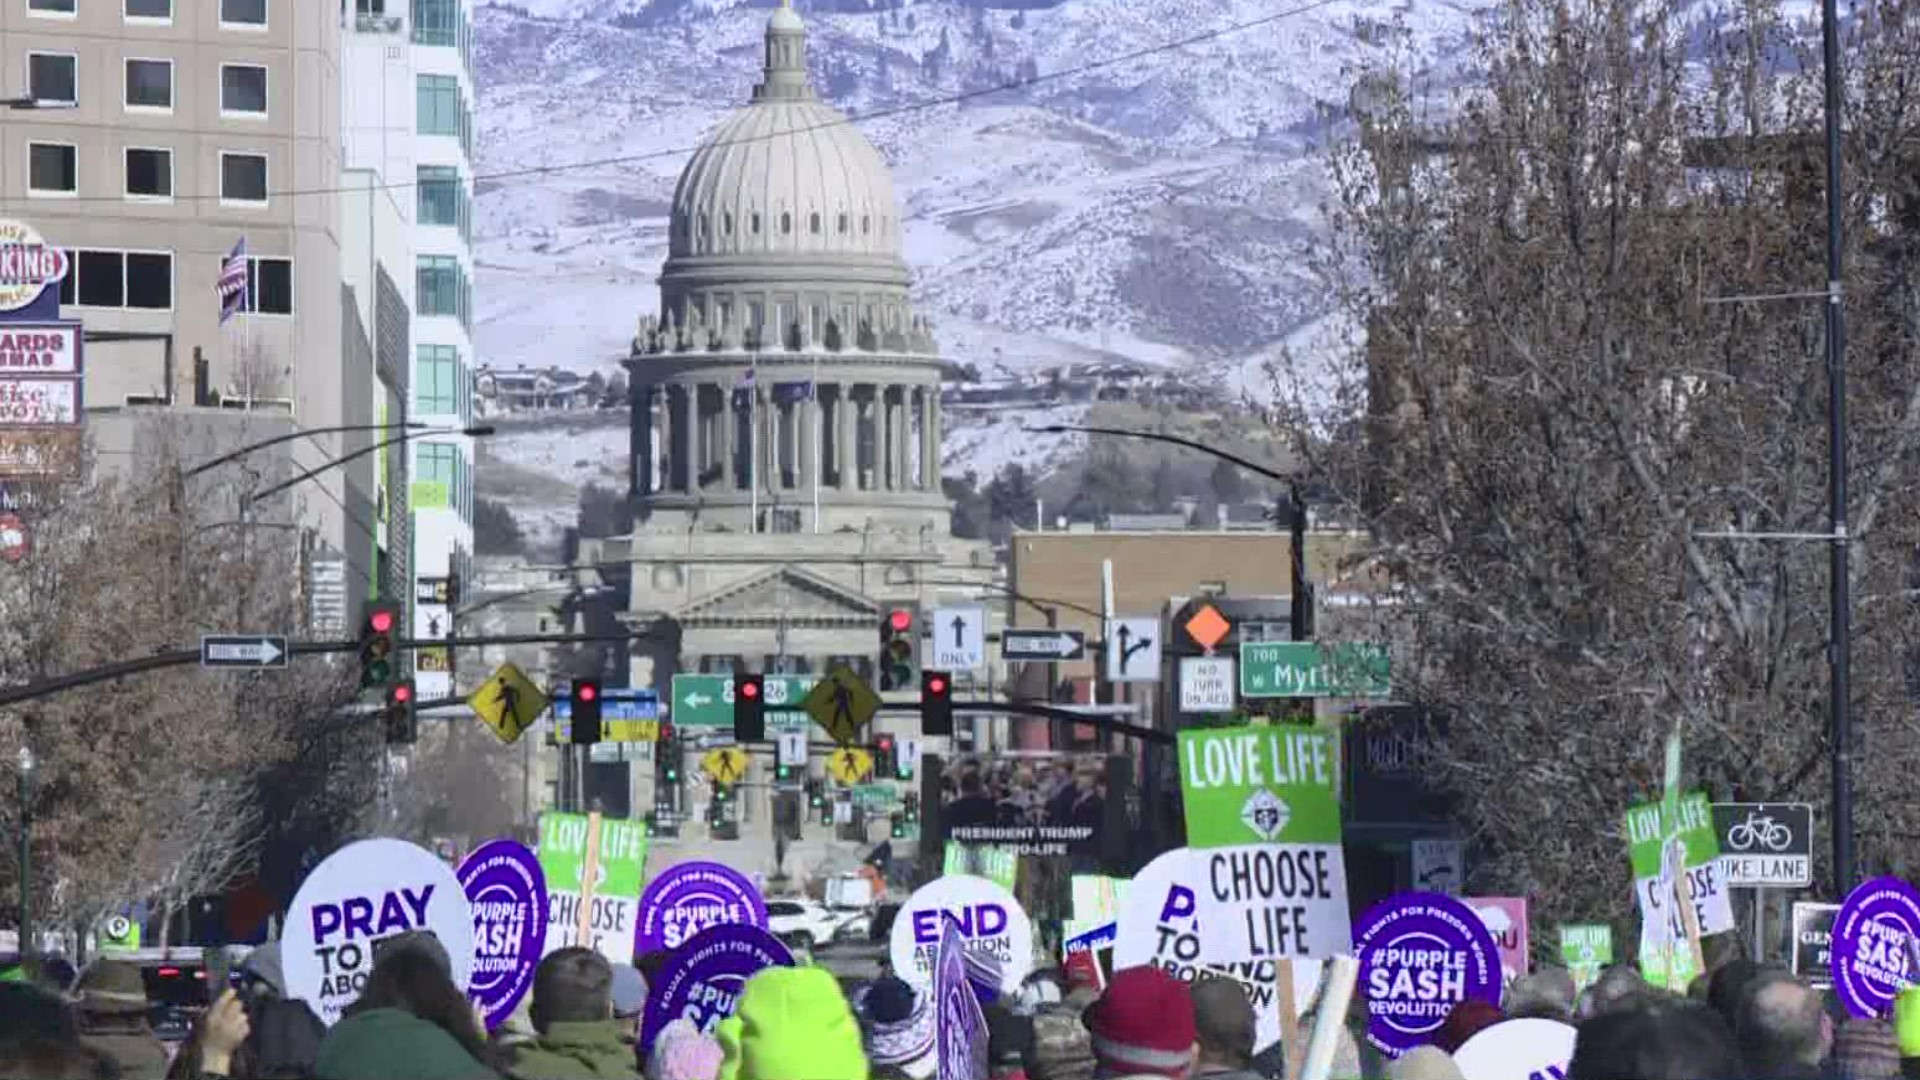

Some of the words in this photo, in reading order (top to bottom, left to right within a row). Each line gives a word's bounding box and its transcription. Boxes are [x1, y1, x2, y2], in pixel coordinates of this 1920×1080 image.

[940, 650, 977, 664] ONLY
[1197, 664, 1218, 675] NO
[1192, 679, 1223, 690] TURN
[1186, 733, 1265, 789] LOVE
[1269, 731, 1330, 787] LIFE
[951, 826, 1034, 840] PRESIDENT
[1039, 826, 1093, 840] TRUMP
[1627, 807, 1662, 845] LOV
[1680, 796, 1708, 833] LIFE
[546, 818, 588, 855] LOV
[602, 820, 641, 860] LIFE
[1210, 850, 1331, 903] CHOOSE
[1761, 859, 1805, 880] LANE
[1647, 865, 1718, 910] COSE
[311, 884, 436, 945] PRAY
[663, 903, 742, 925] #PURPLE
[912, 903, 1008, 943] END
[730, 940, 753, 954] FOR
[914, 936, 1011, 959] ABTION
[1156, 925, 1200, 961] TO
[1246, 906, 1310, 956] LIFE
[314, 942, 363, 975] TO
[1371, 949, 1468, 971] #PURPLE
[1369, 967, 1466, 1003] SASH
[1369, 1000, 1452, 1018] REVOLUTIO
